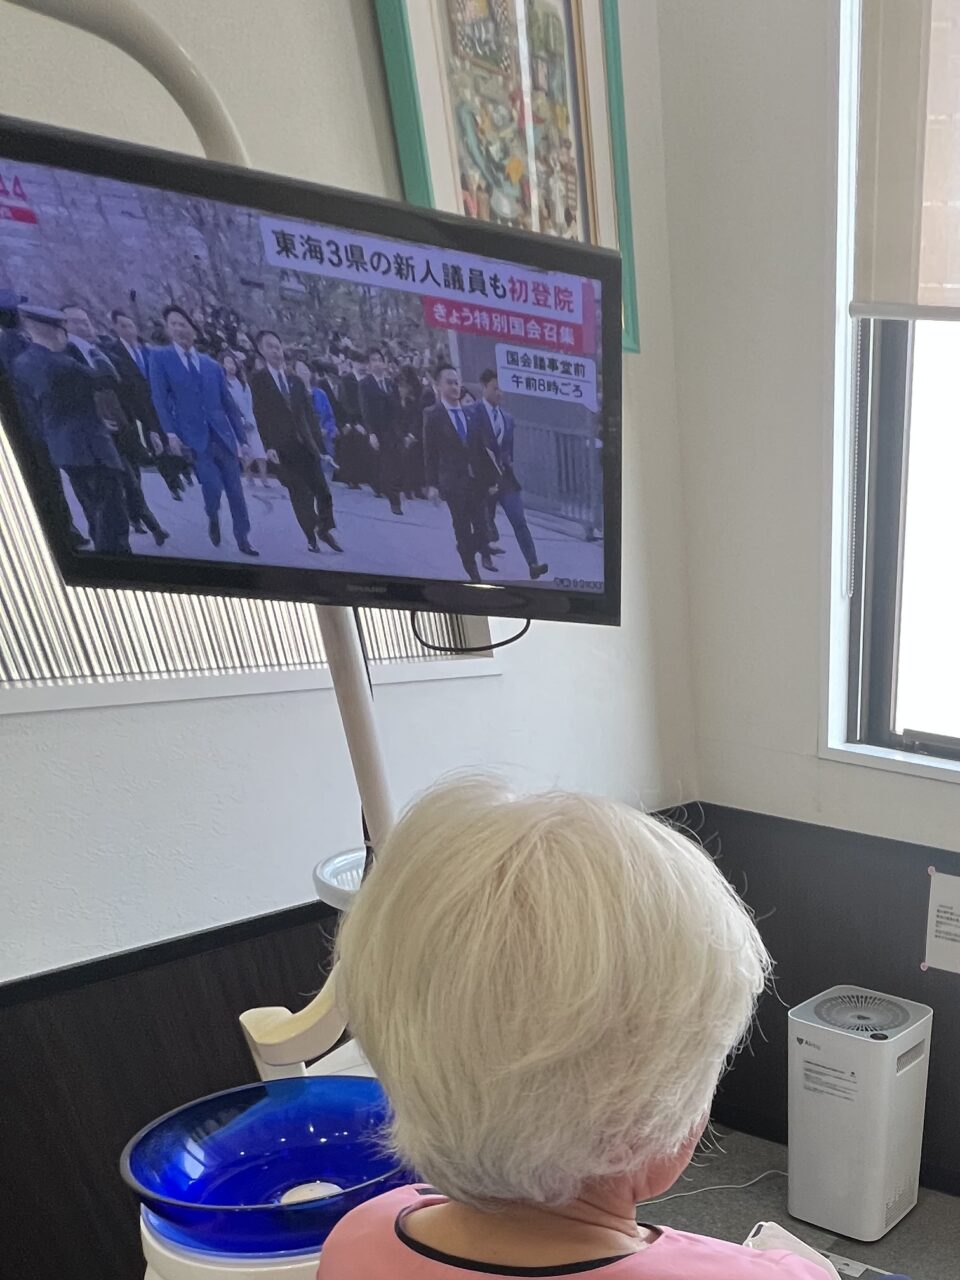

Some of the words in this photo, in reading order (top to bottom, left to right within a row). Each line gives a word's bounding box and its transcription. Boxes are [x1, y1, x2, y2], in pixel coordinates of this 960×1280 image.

[272, 229, 575, 314] 東海3県の新人議員も初登院
[432, 302, 576, 346] きょう特別国会召集
[506, 350, 587, 378] 国会議事堂前
[511, 374, 584, 399] 午前8時ごろ
